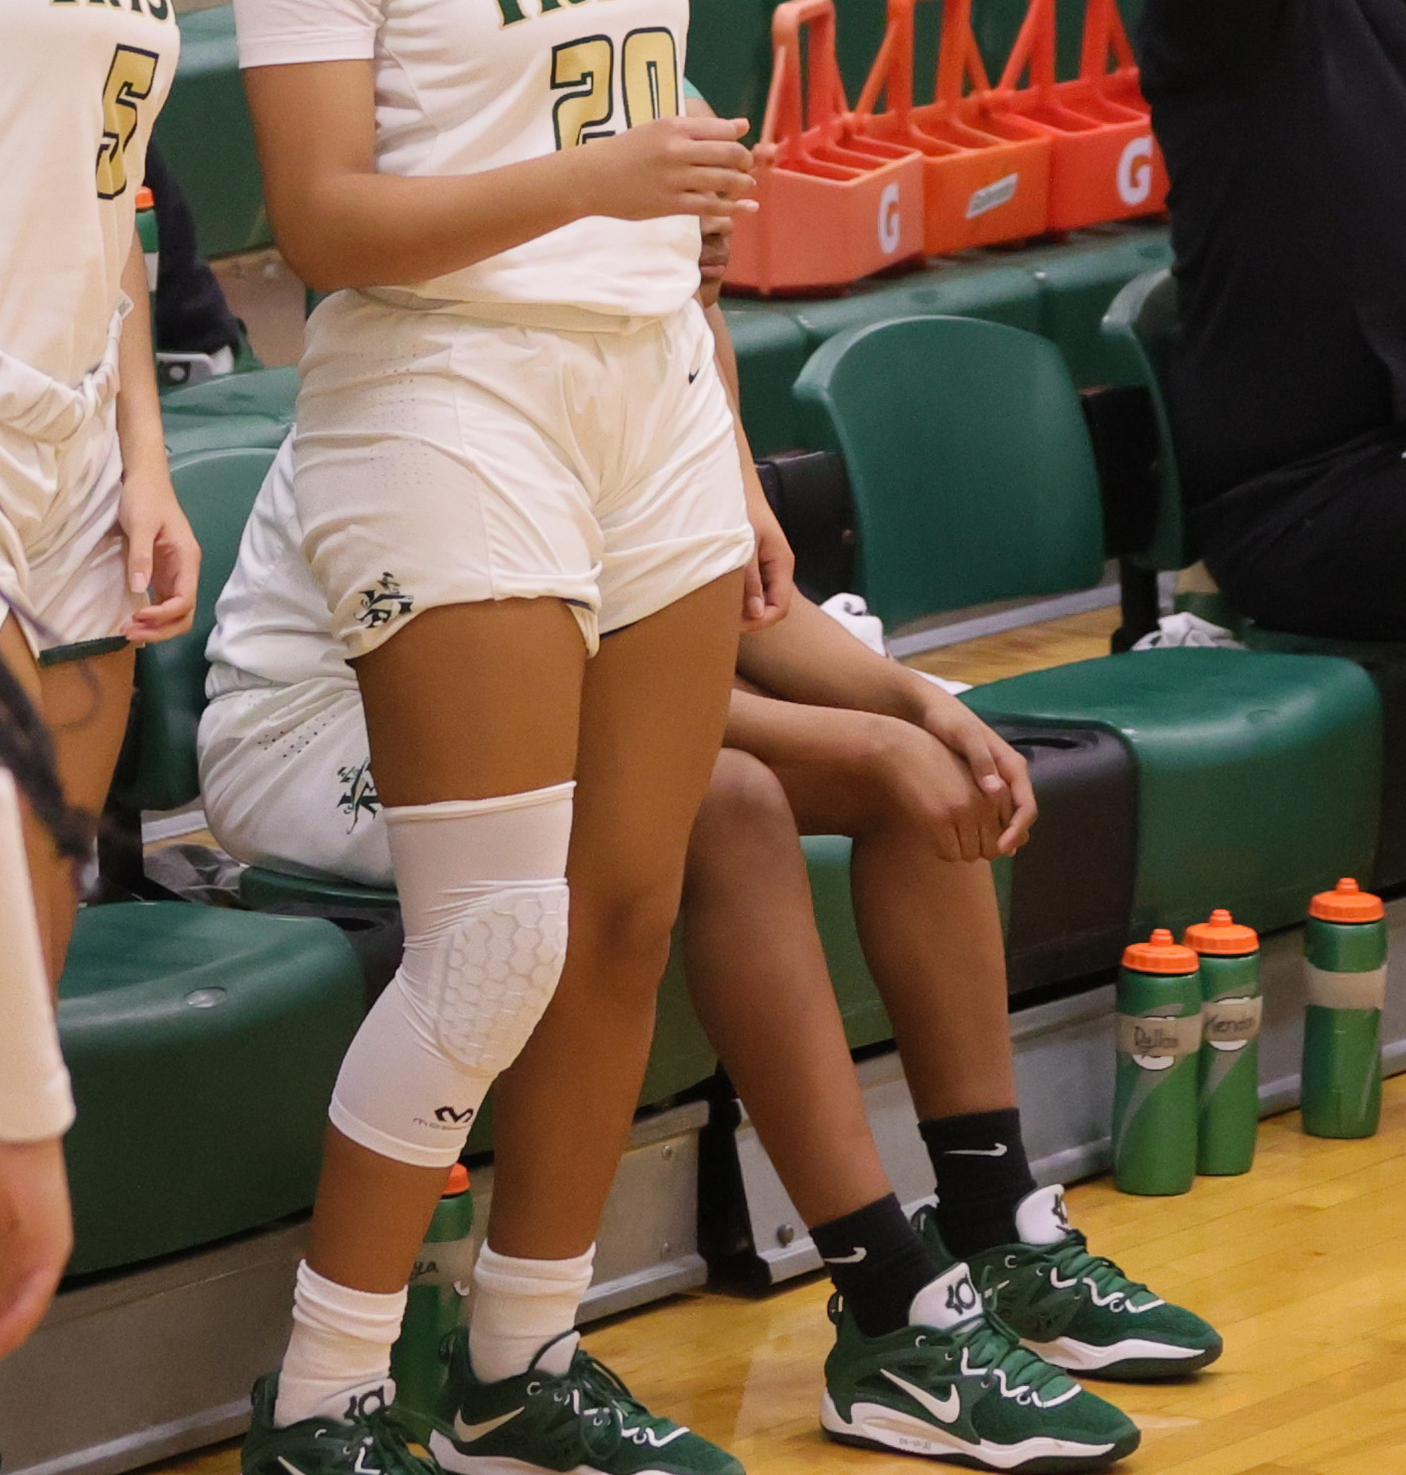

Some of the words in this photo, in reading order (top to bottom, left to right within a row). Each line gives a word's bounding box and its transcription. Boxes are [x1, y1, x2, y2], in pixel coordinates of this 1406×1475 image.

[95, 42, 160, 200] 5
[550, 26, 680, 152] 20
[877, 182, 901, 254] G
[1116, 134, 1153, 206] G
